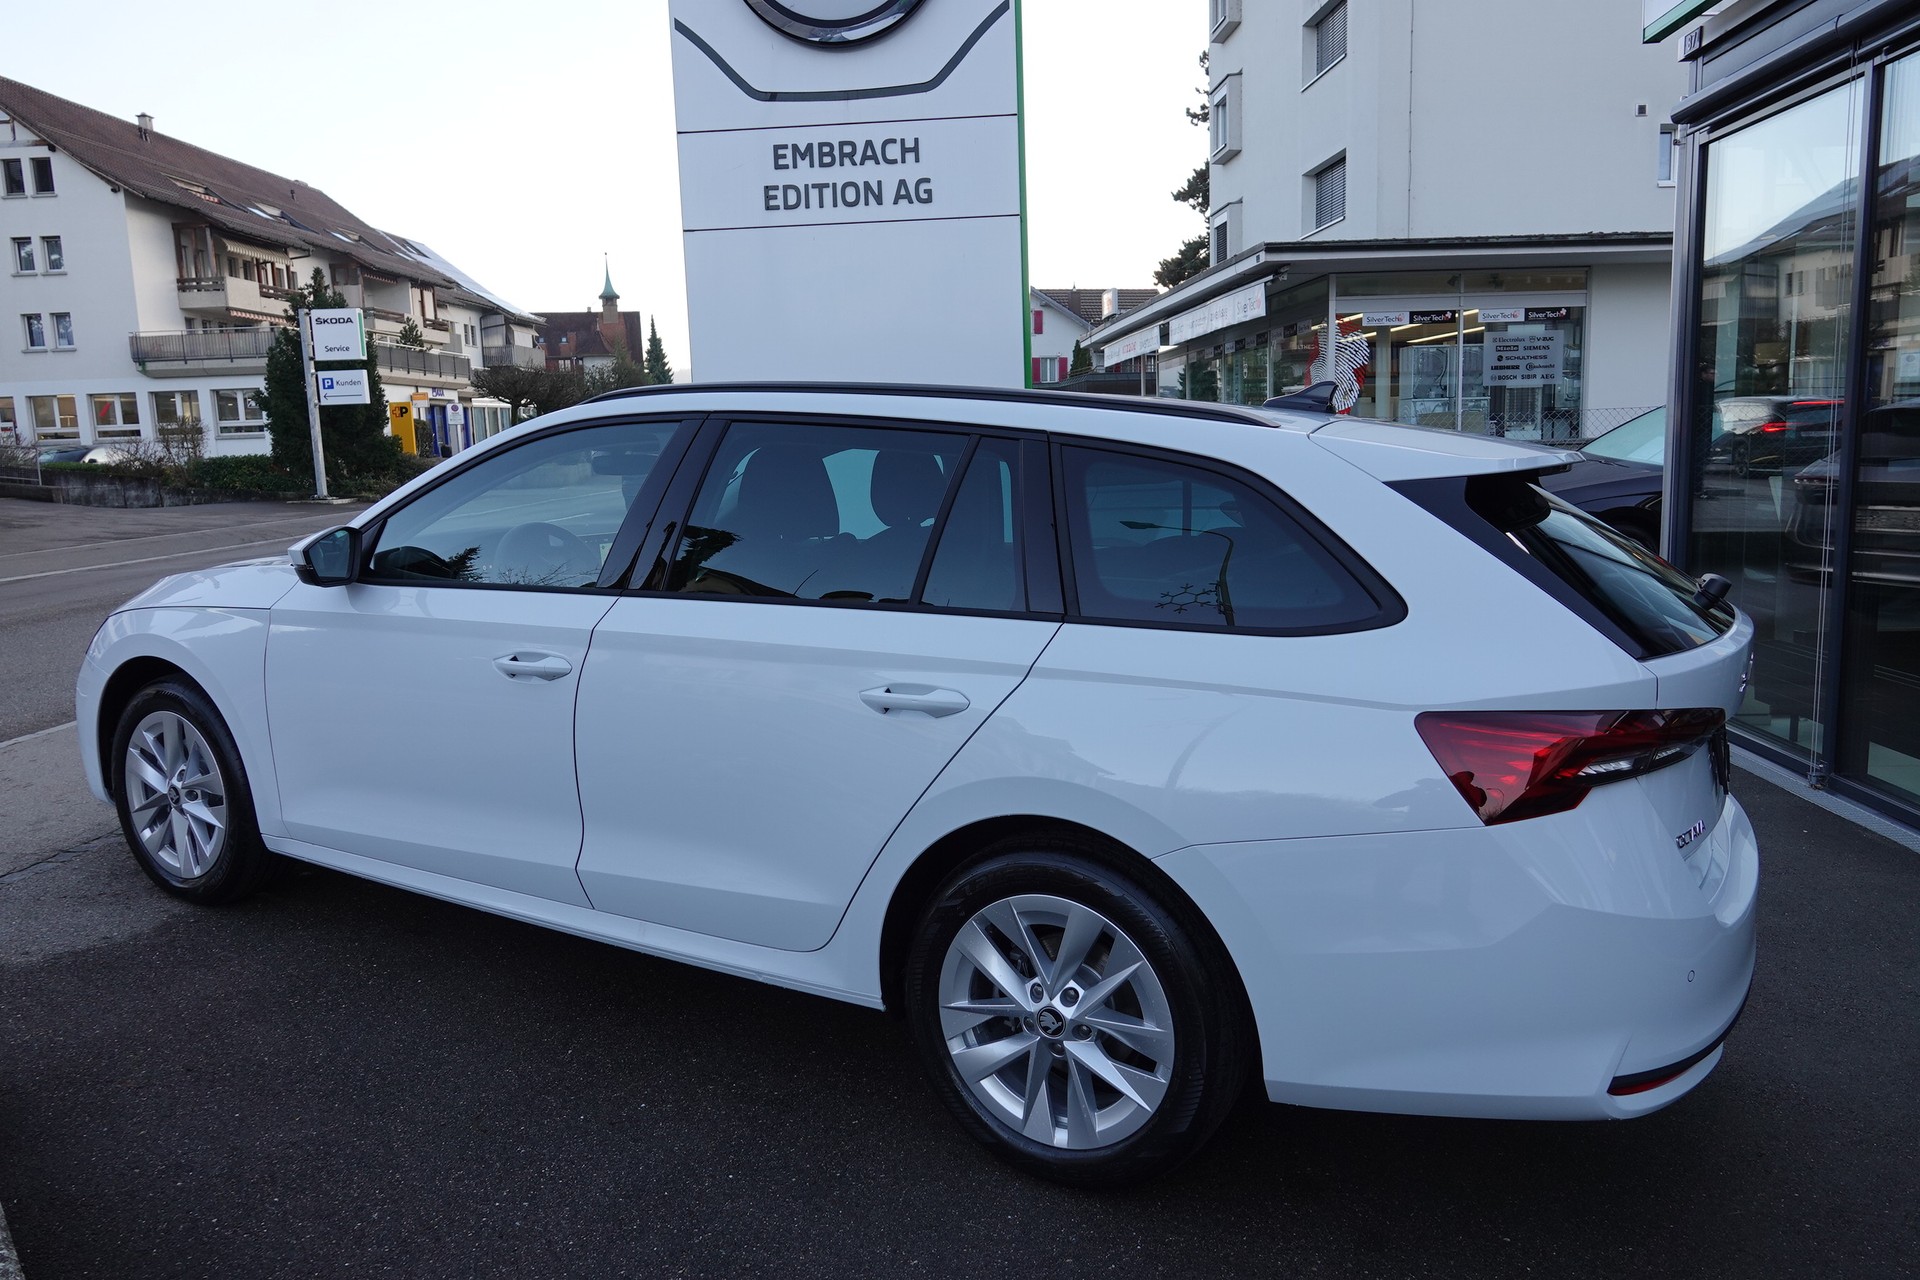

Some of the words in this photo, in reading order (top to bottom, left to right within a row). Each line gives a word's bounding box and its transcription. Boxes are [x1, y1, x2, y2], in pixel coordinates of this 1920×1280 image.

[772, 137, 920, 170] EMBRACH
[763, 180, 883, 211] EDITION
[893, 177, 933, 205] AG
[1366, 315, 1400, 323] SilverTech
[1413, 313, 1446, 321] SilverTech
[1482, 312, 1515, 320] SilverTech
[315, 316, 354, 326] ŠKODA
[324, 345, 350, 353] Service
[336, 379, 362, 387] Kunden
